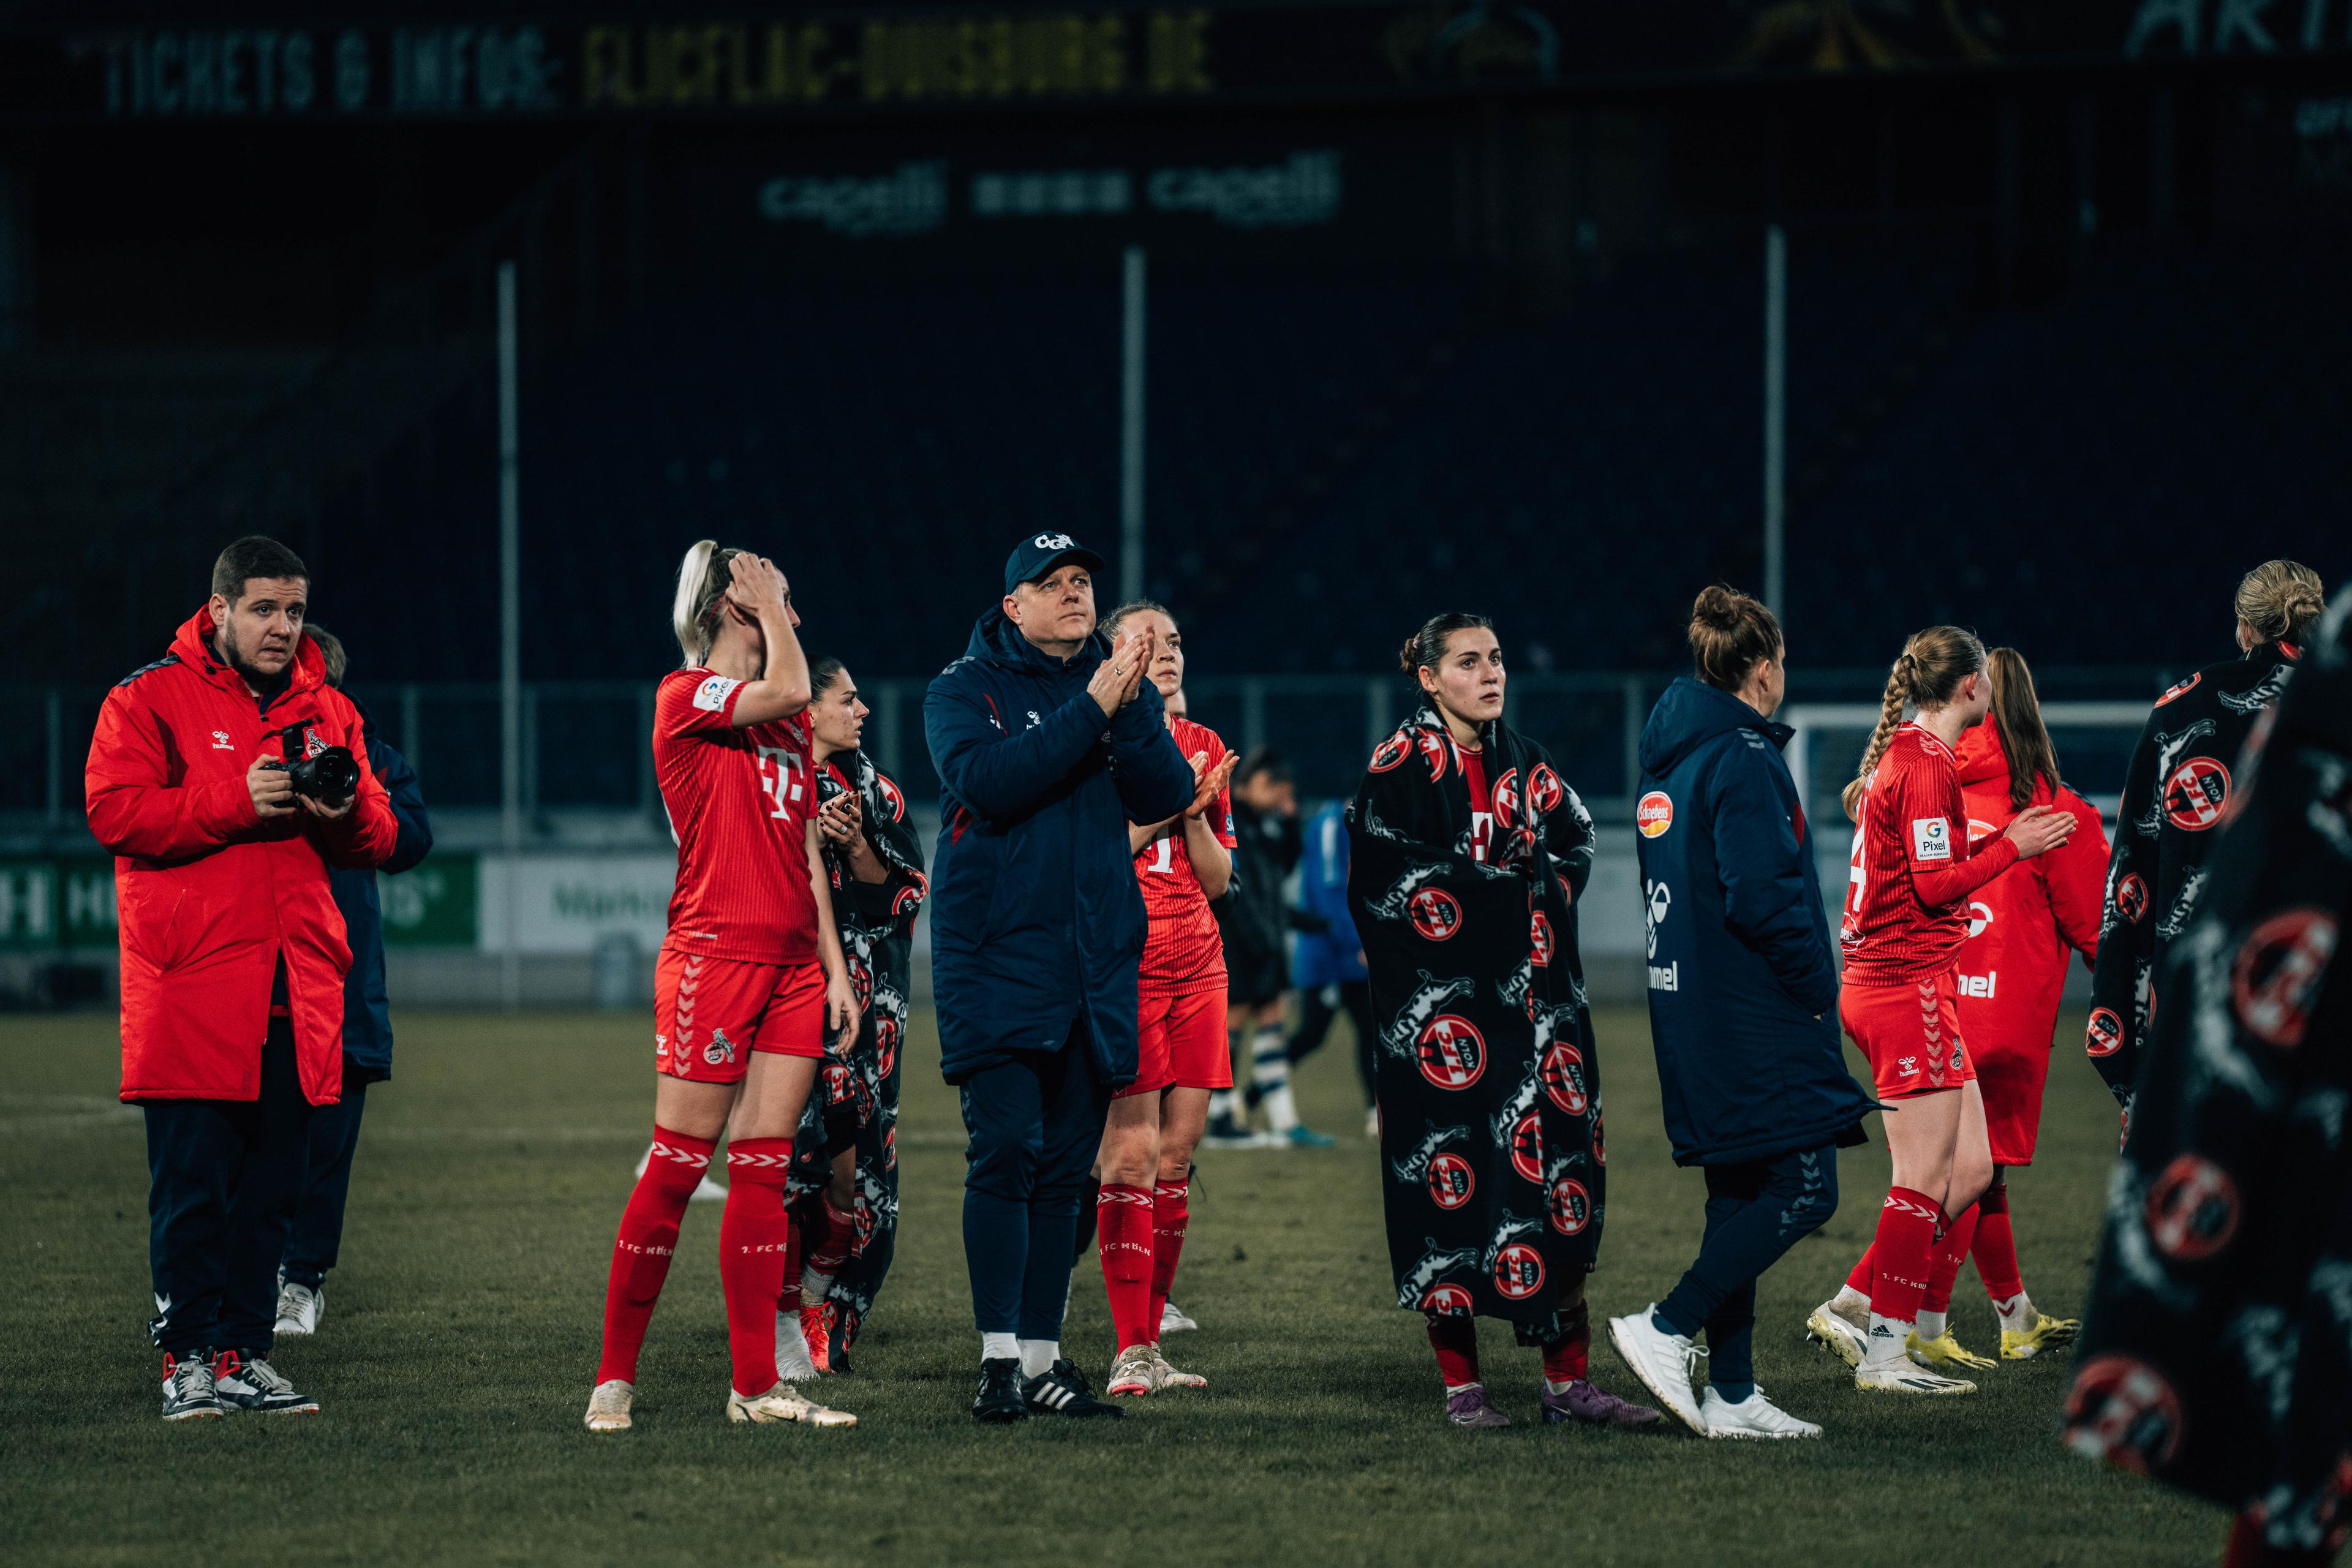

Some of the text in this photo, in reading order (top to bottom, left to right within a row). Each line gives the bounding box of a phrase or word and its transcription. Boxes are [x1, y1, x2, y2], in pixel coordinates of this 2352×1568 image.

[103, 28, 315, 116] TICKETS
[1639, 804, 1668, 820] Schaebens
[1923, 840, 1945, 851] Pixel
[1899, 1068, 1920, 1077] hummel
[627, 1243, 642, 1254] FC
[756, 1244, 774, 1253] FC
[1894, 1276, 1907, 1284] FC
